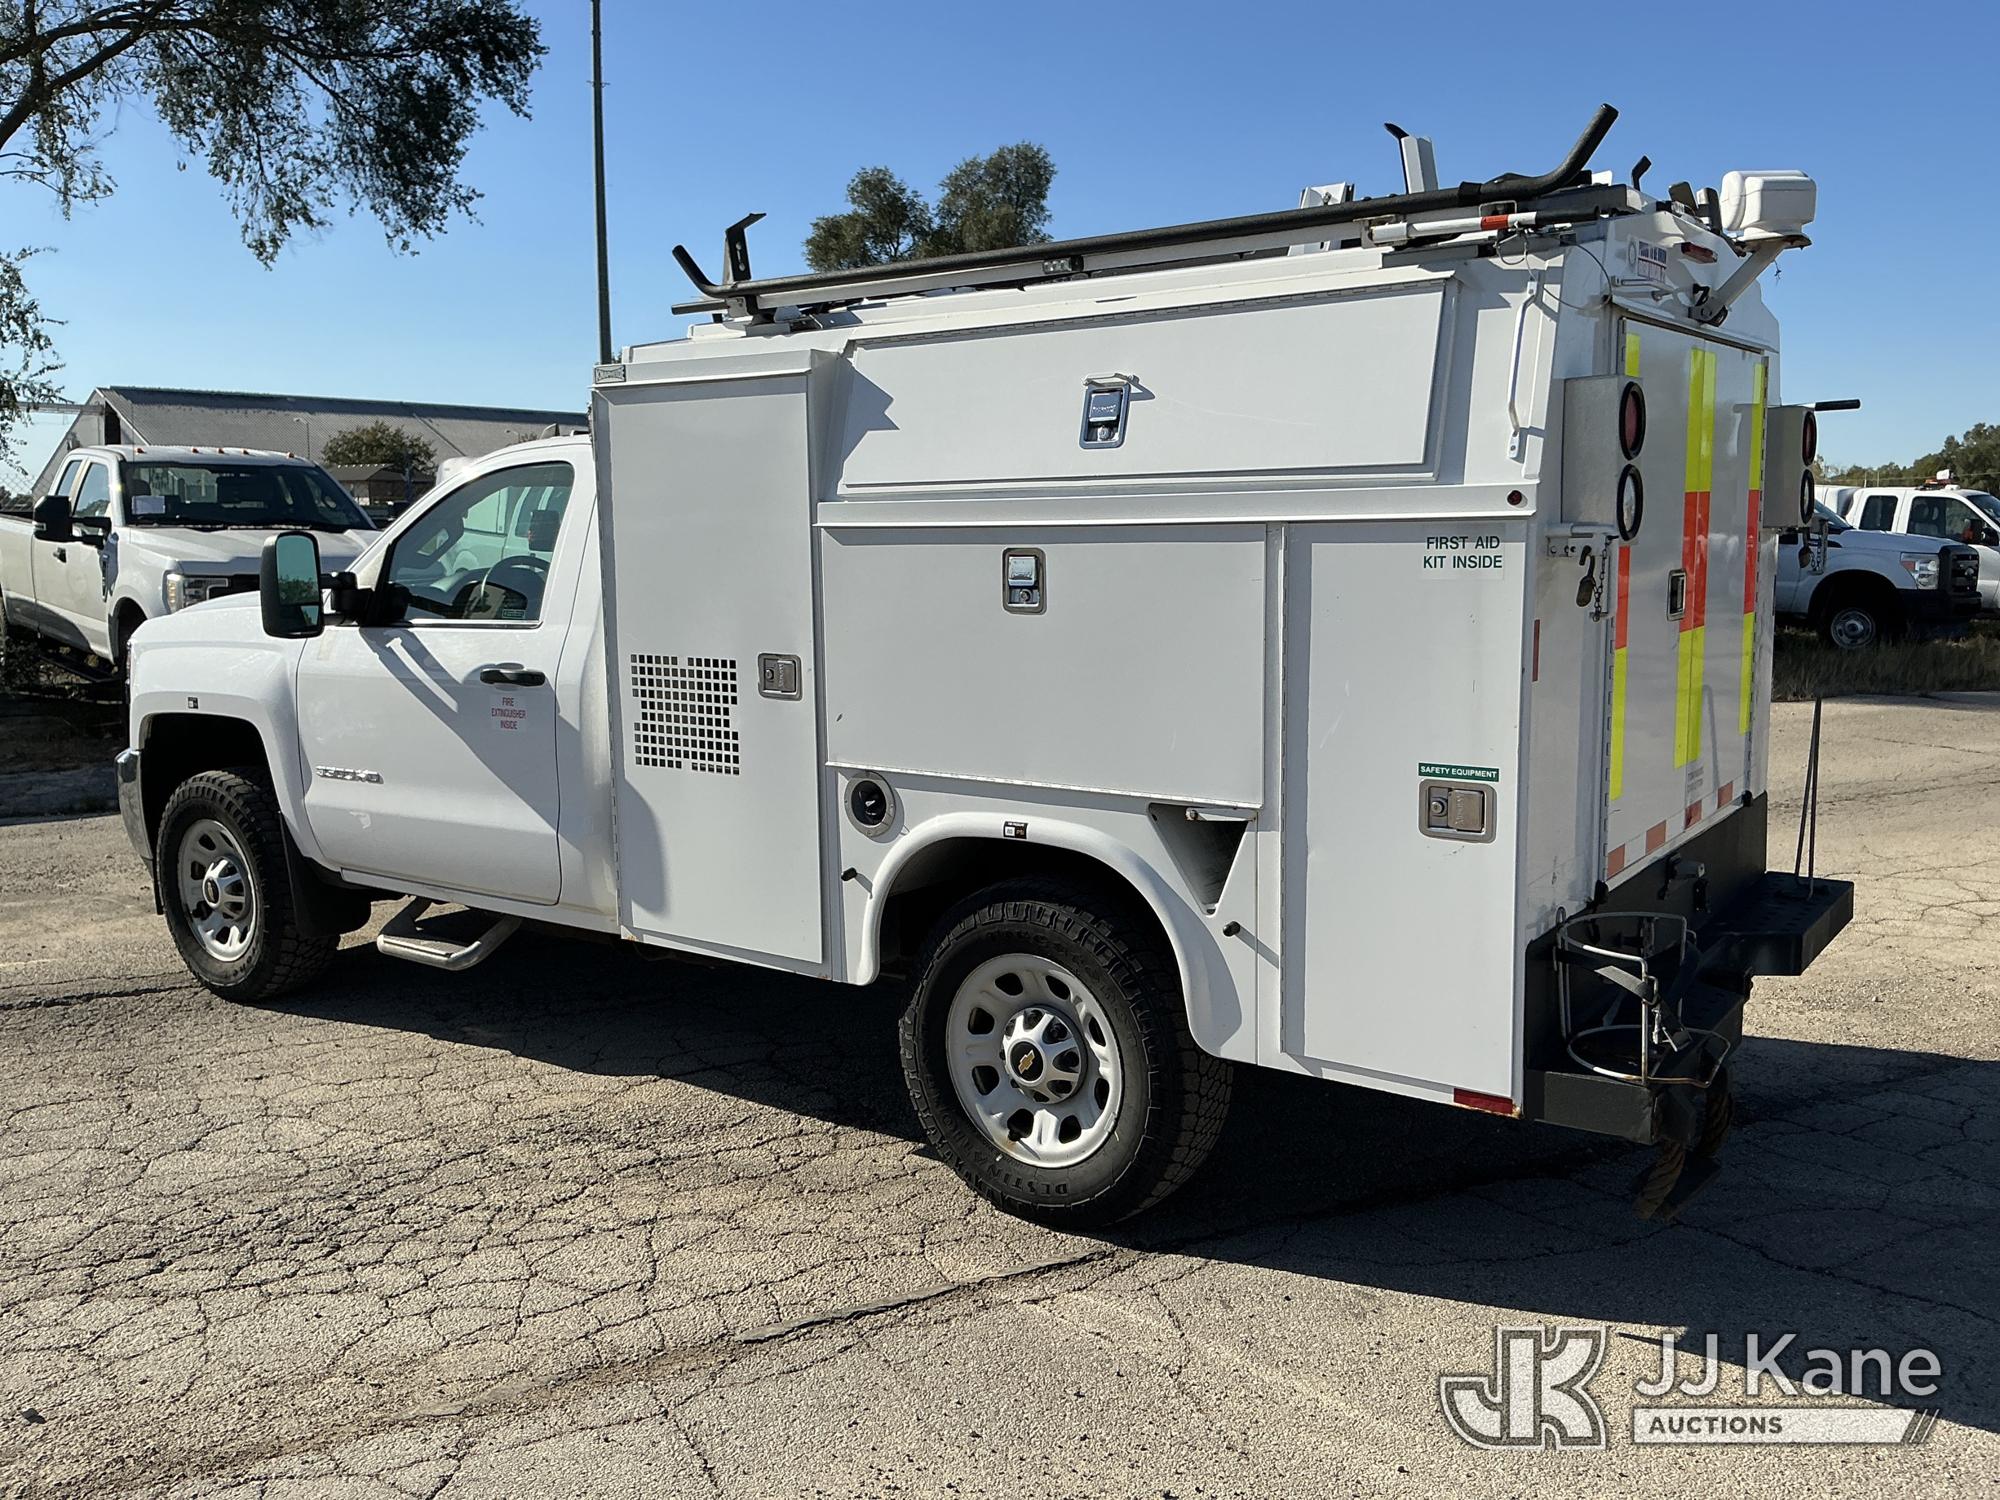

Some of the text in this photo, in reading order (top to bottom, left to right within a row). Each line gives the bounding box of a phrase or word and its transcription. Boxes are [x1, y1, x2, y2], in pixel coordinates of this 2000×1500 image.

[1426, 535, 1501, 550] FIRST AID
[1423, 555, 1503, 569] KIT INSIDE
[502, 696, 515, 707] FIRE
[491, 707, 526, 719] EXTINGUISHER
[500, 719, 518, 730] INSIDE
[1420, 765, 1498, 778] SAFETY EQUIPMENT
